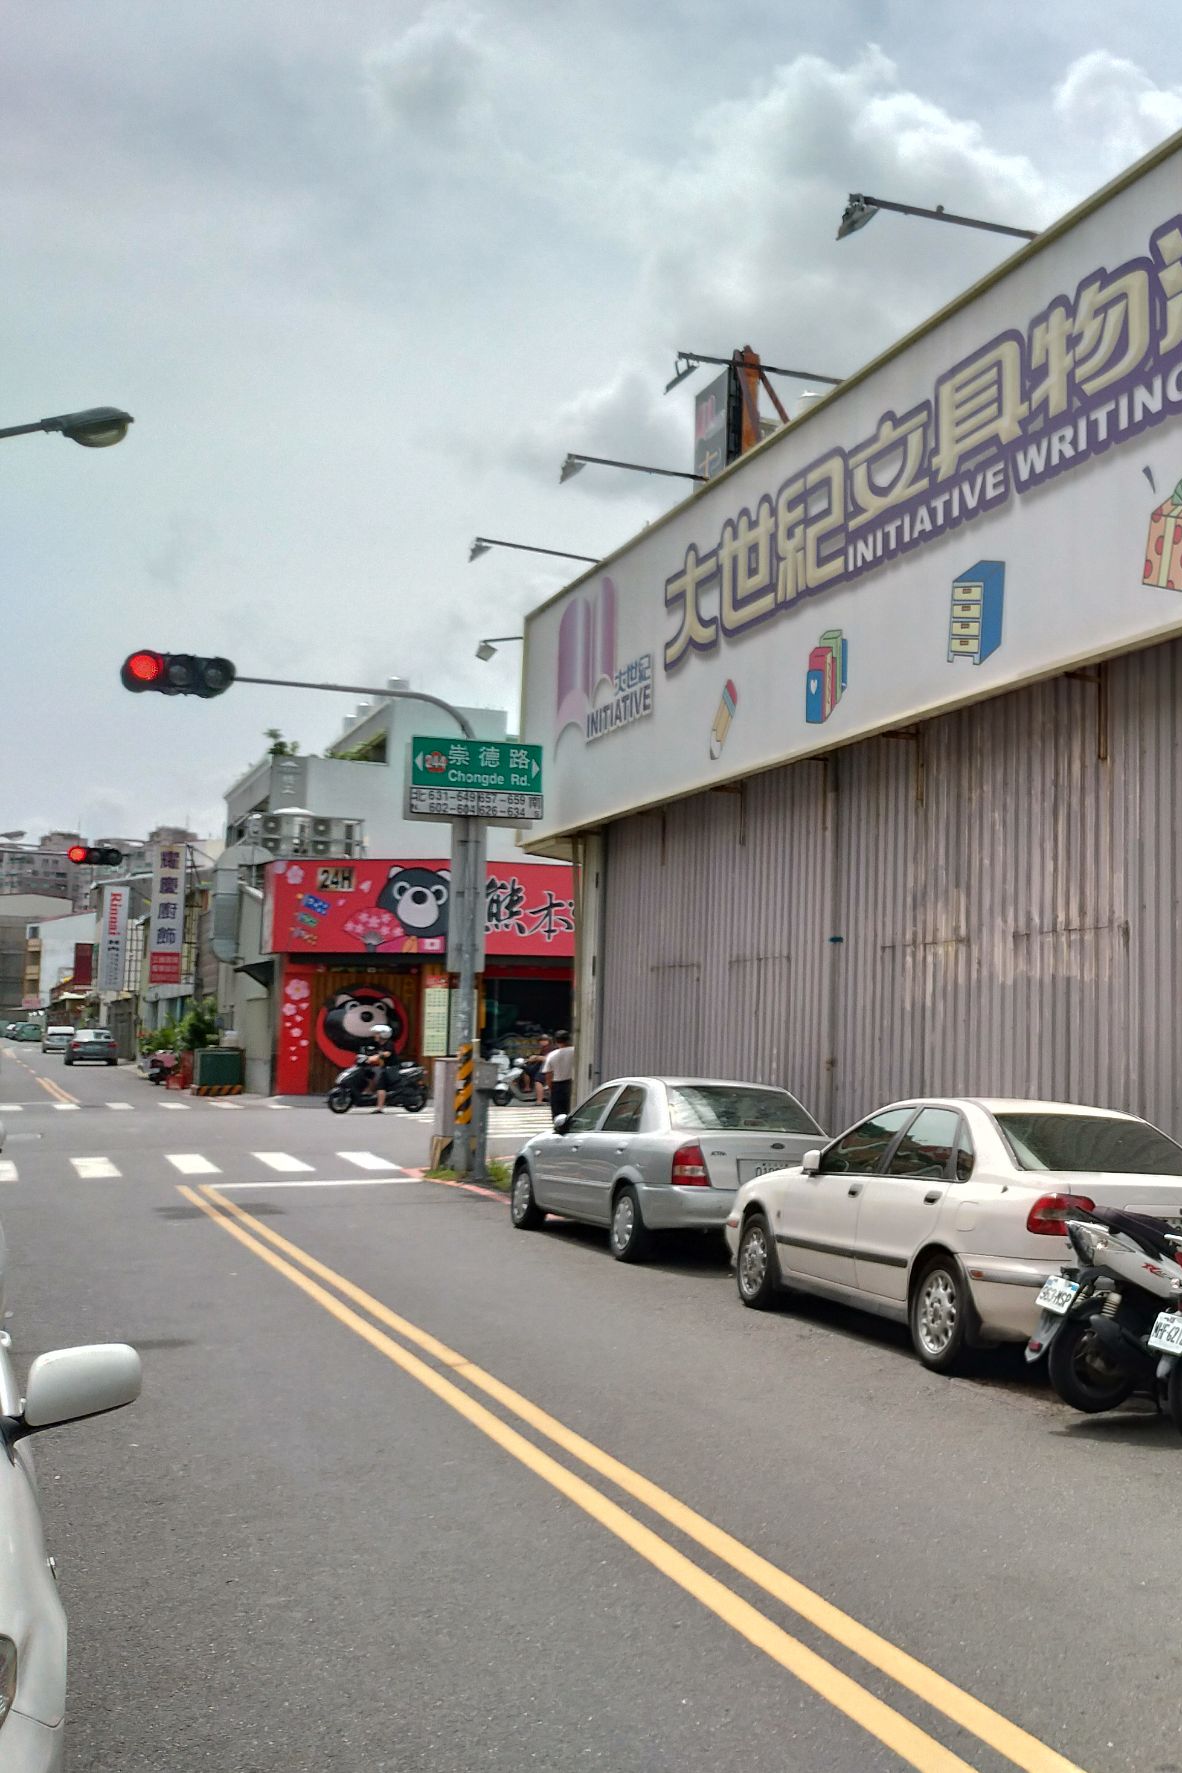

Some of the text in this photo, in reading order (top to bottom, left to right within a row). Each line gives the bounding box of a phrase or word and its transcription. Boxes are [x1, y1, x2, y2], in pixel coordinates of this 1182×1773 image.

[847, 461, 1005, 572] INITIATIVE
[615, 654, 651, 696] 大世紀
[586, 684, 651, 739] INITIATIVE
[448, 744, 531, 769] 崇德路
[448, 770, 531, 786] Chongde Rd.
[319, 869, 351, 890] 24H
[109, 892, 122, 936] Rinnai
[485, 875, 576, 942] 熊本
